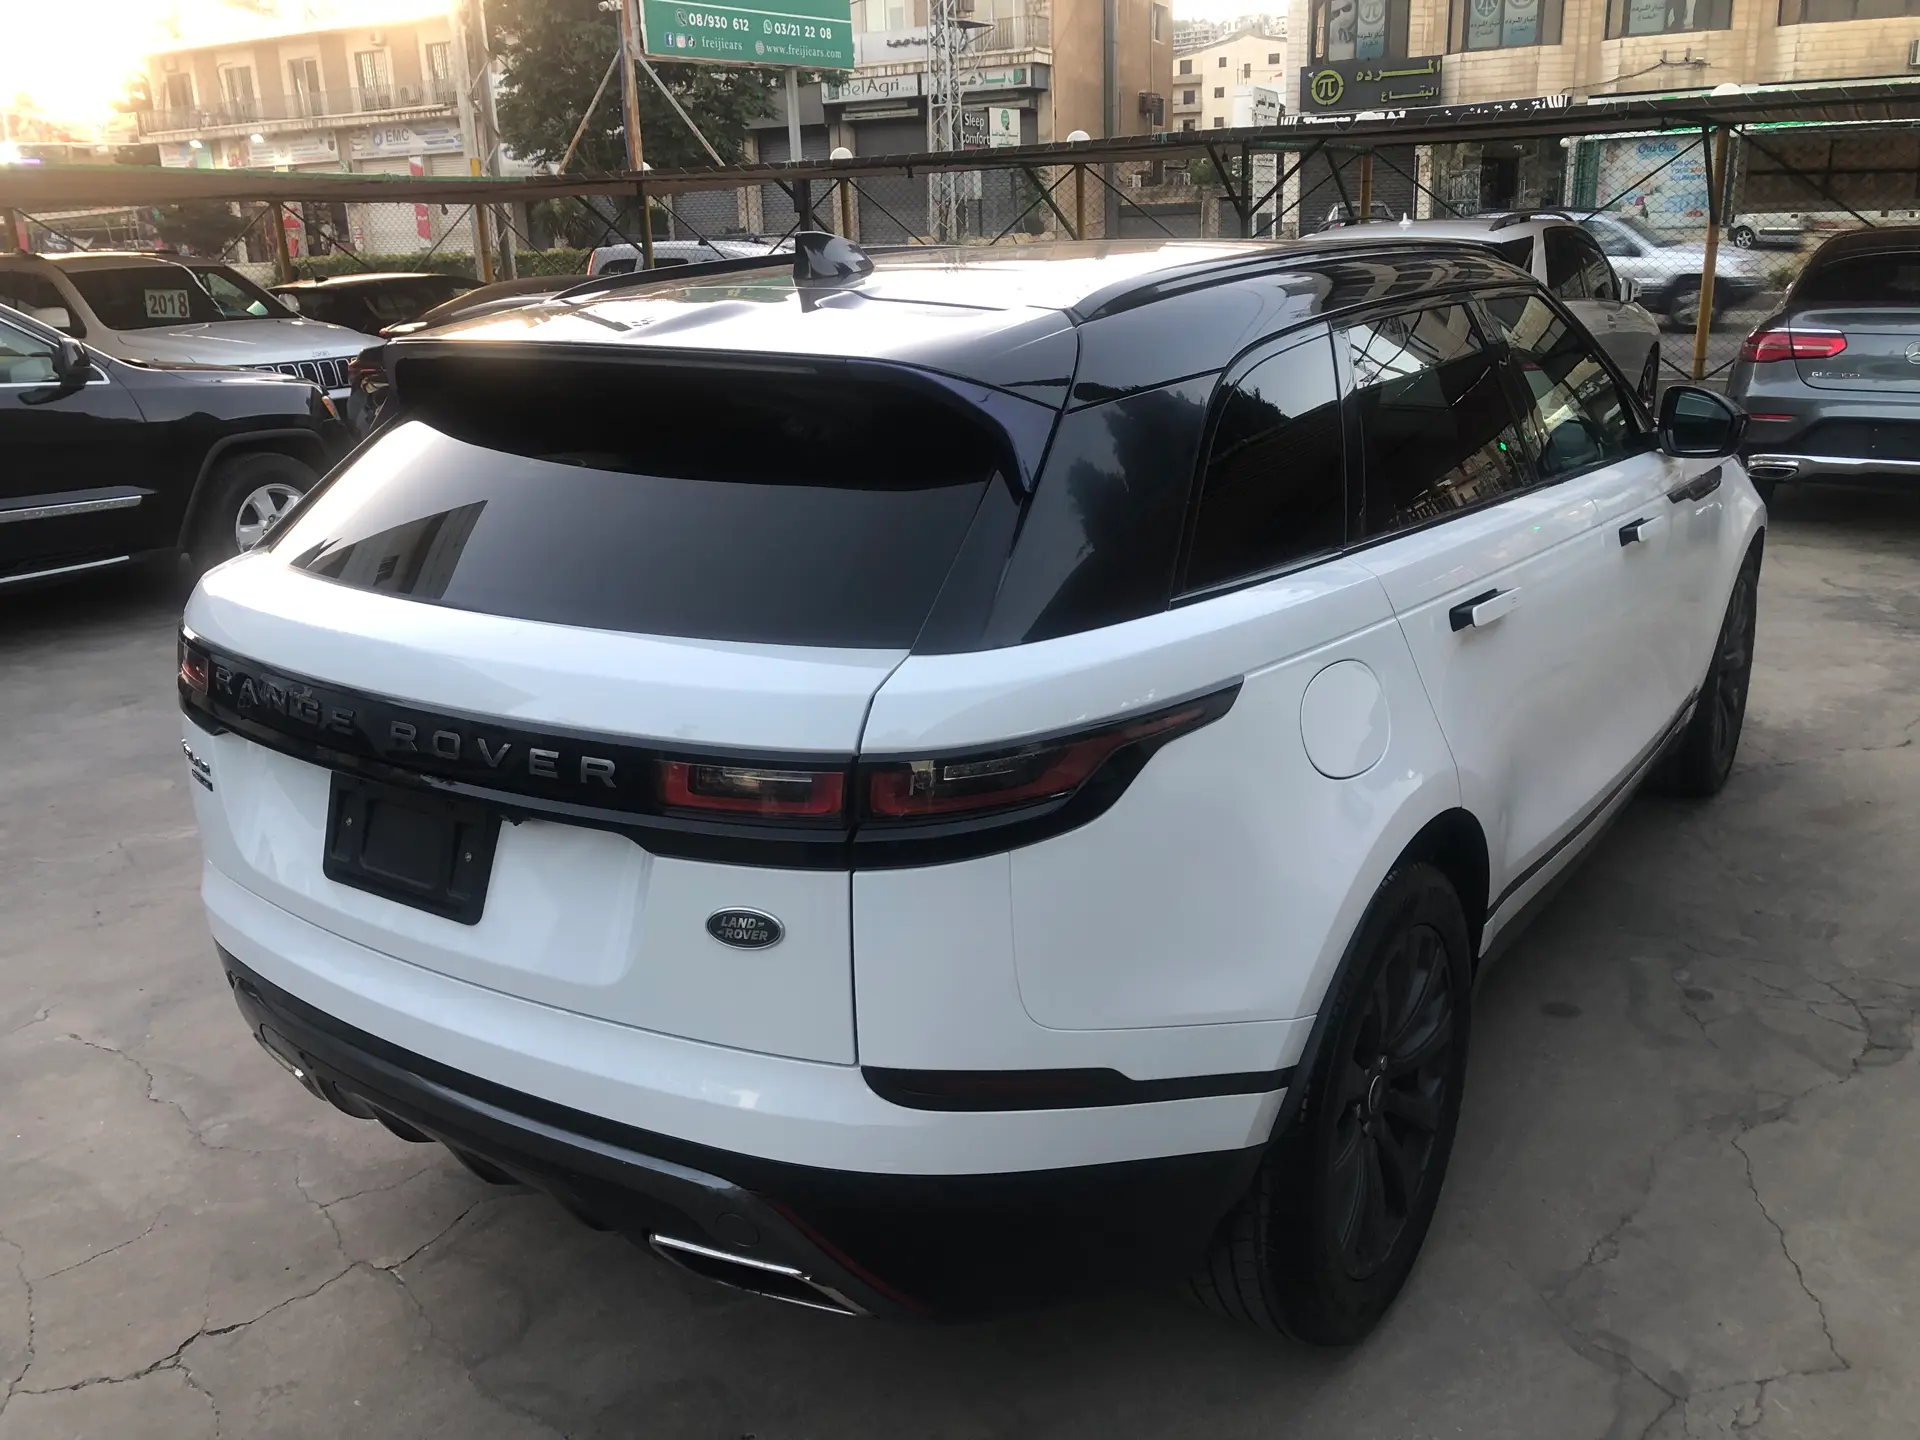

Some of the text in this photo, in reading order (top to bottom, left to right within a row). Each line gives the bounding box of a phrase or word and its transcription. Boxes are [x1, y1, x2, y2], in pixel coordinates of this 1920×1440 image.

[689, 13, 749, 32] 08/930 612
[775, 23, 832, 40] 03/21 22 08
[702, 36, 743, 51] freijicars
[766, 42, 842, 59] www.freijicars.com
[841, 79, 899, 98] BelAgri
[964, 113, 985, 130] Sleep
[386, 128, 409, 142] EMC
[962, 132, 990, 145] omfort
[149, 292, 188, 317] 2018
[215, 666, 617, 789] RANGE ROVER
[721, 916, 757, 929] LAND
[725, 928, 769, 941] ROVER
